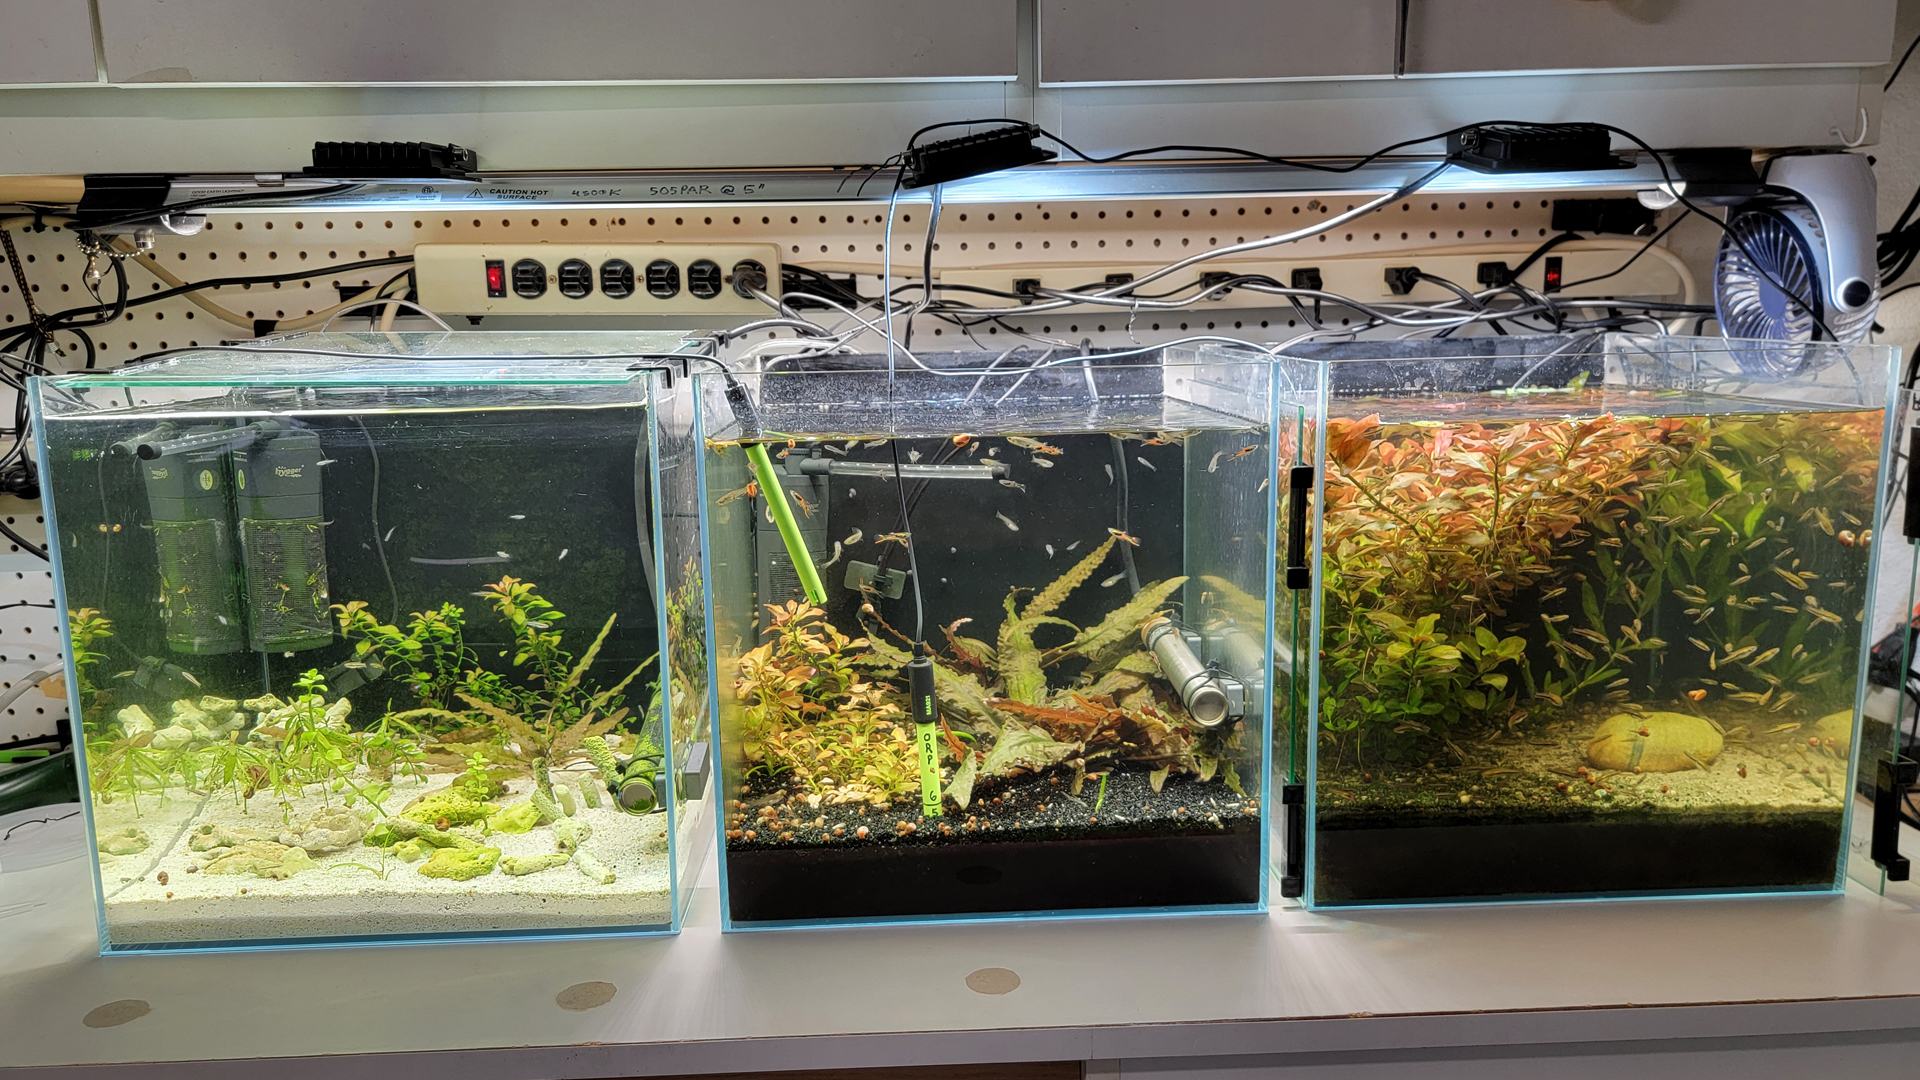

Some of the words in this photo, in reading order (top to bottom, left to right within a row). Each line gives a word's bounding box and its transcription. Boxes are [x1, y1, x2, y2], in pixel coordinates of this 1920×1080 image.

[571, 189, 622, 197] 4500K
[650, 184, 712, 195] 505PAR
[720, 185, 736, 195] @
[275, 467, 302, 477] hygger
[923, 733, 933, 765] ORP
[929, 790, 938, 802] 6
[931, 807, 939, 817] 5
